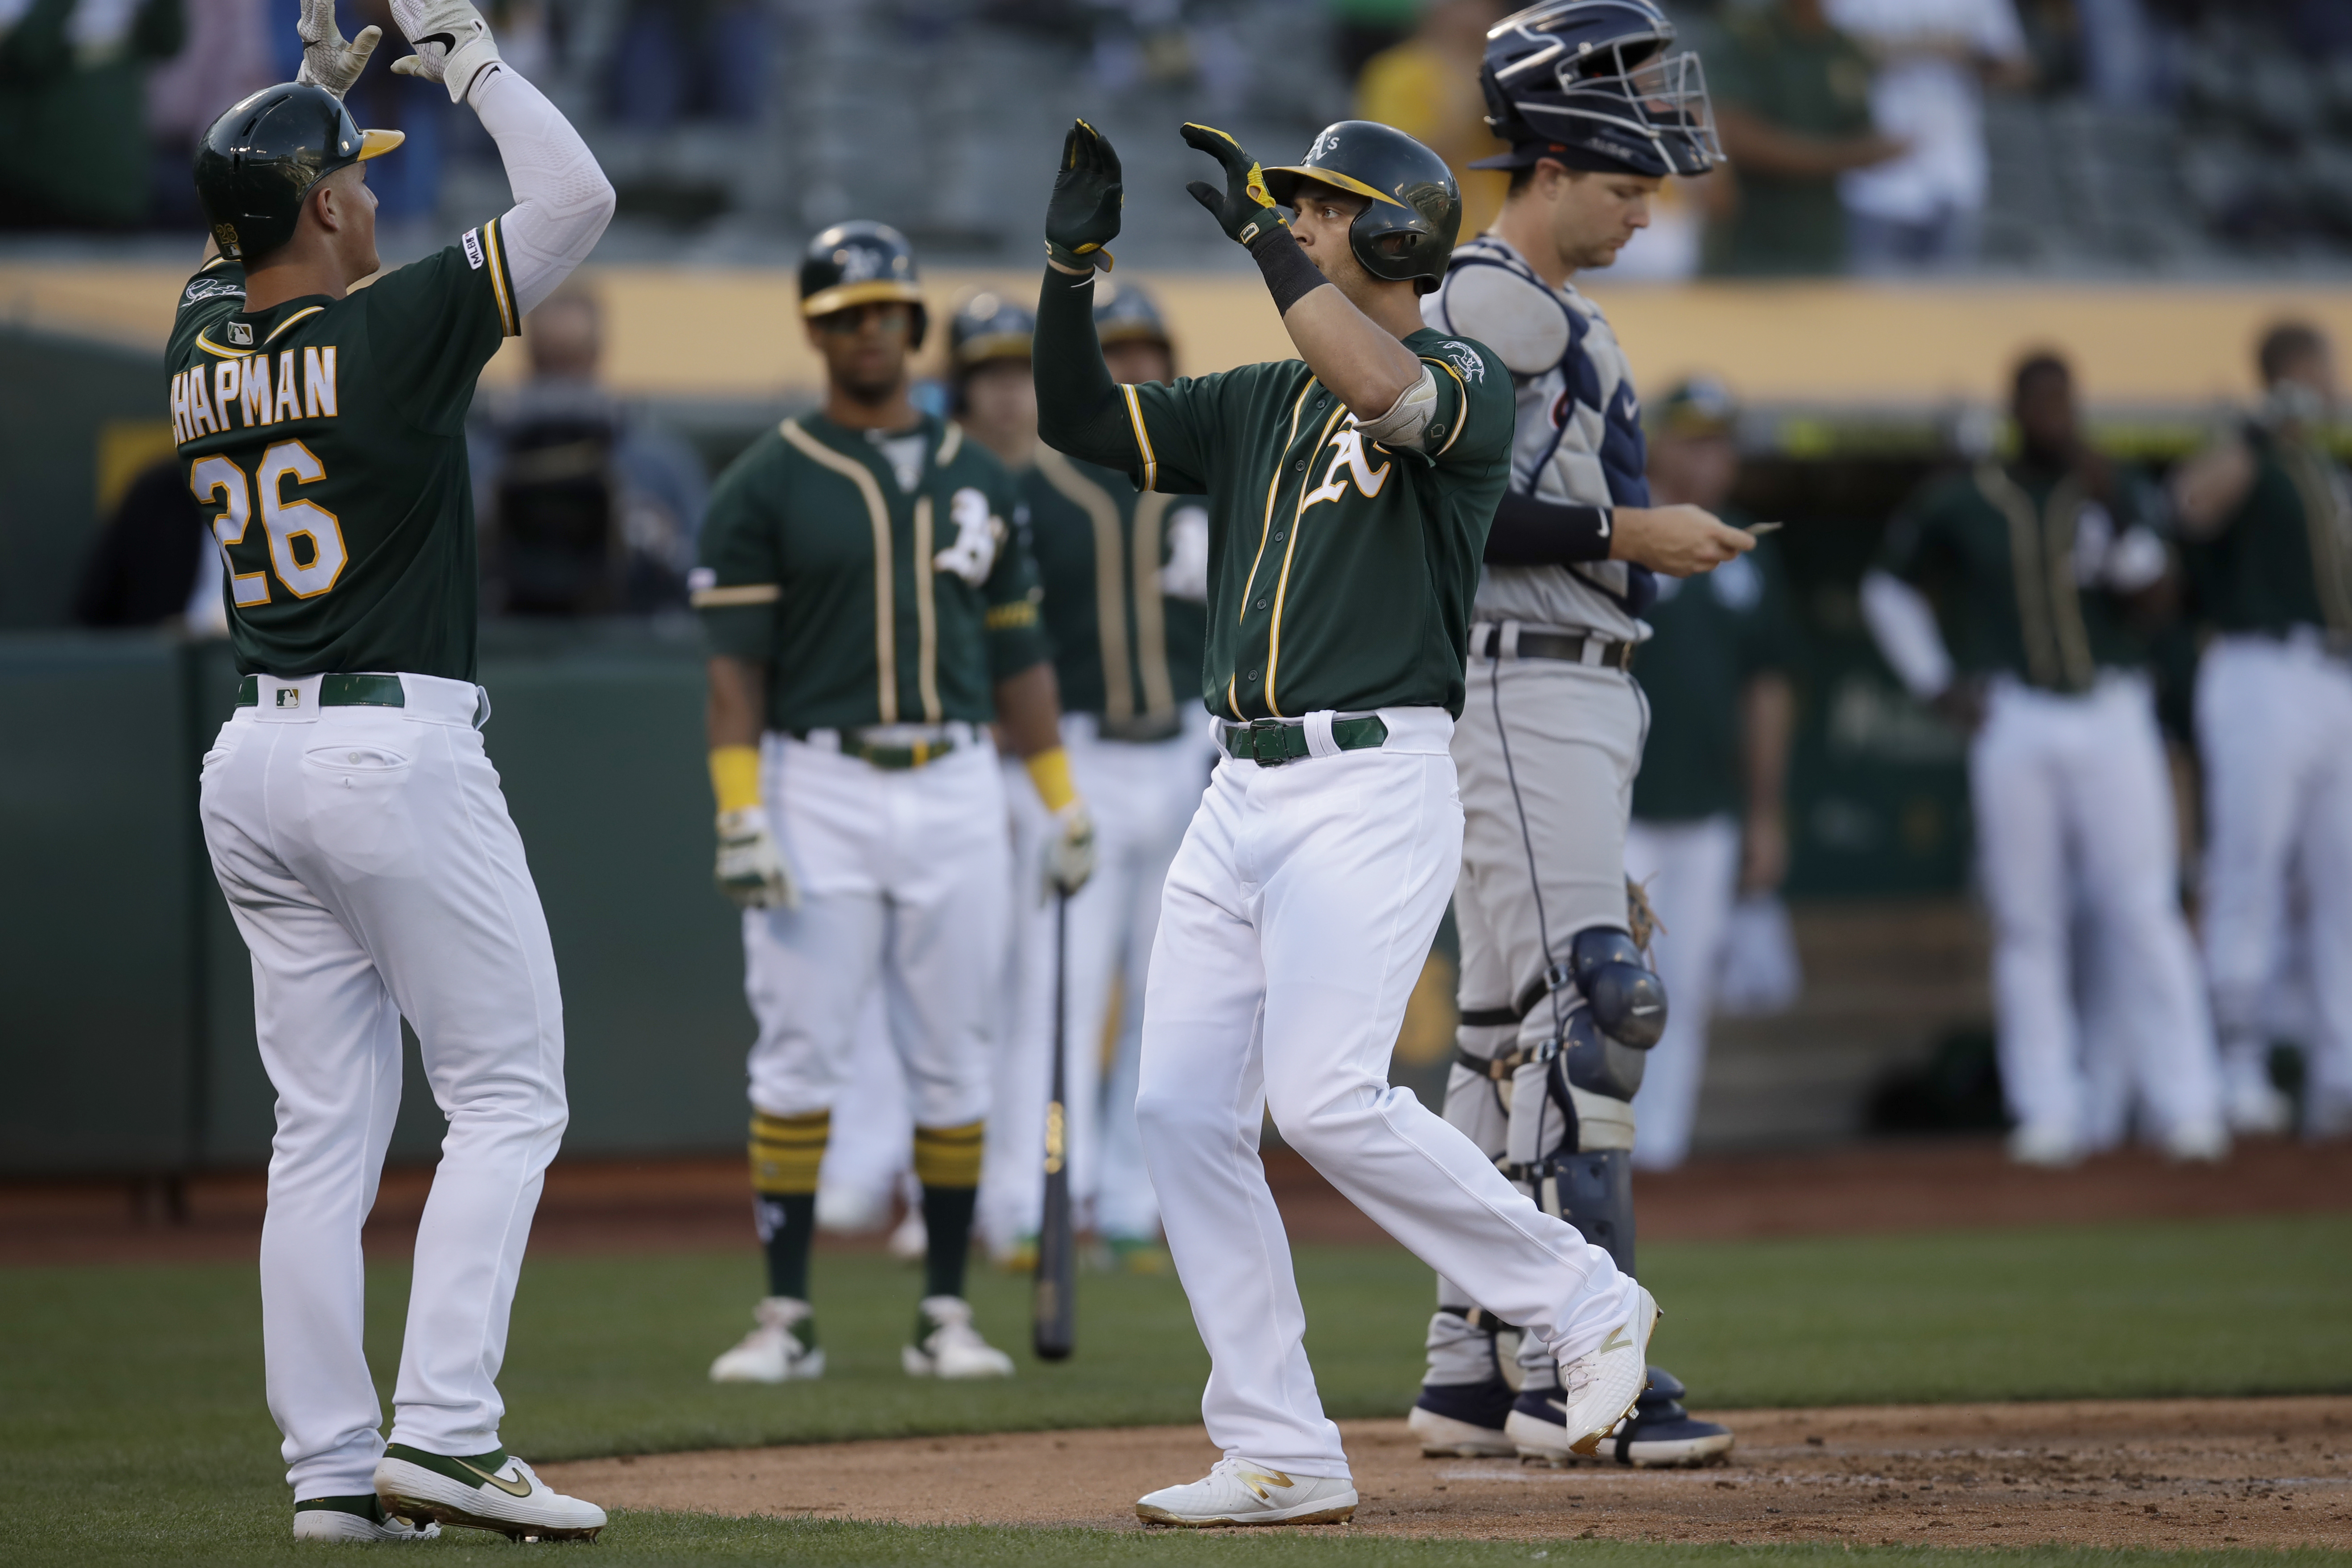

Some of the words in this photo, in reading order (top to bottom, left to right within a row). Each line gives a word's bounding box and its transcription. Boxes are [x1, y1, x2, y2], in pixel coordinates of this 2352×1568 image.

[1301, 130, 1340, 165] A's
[216, 223, 238, 244] 26
[465, 242, 482, 265] MLB
[170, 346, 338, 448] HAPMAN
[190, 438, 348, 608] 26
